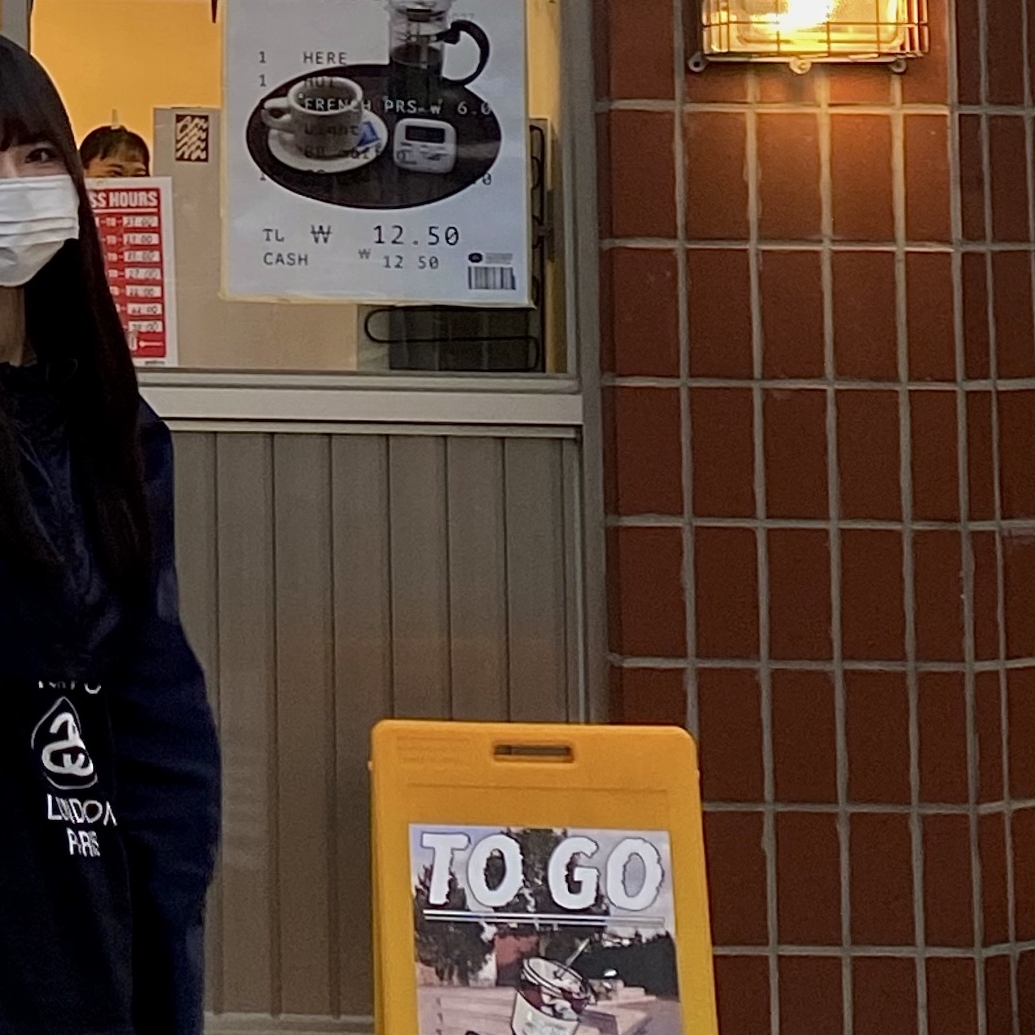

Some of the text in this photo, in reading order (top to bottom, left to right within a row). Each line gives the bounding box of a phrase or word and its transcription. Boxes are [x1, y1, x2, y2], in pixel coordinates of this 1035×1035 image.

[258, 51, 349, 65] 1 HERE
[258, 74, 267, 88] 1
[108, 191, 158, 208] HOURS
[262, 228, 285, 242] TL
[373, 225, 460, 246] 12.50
[262, 251, 309, 267] CASH
[421, 831, 666, 913] TO GO
